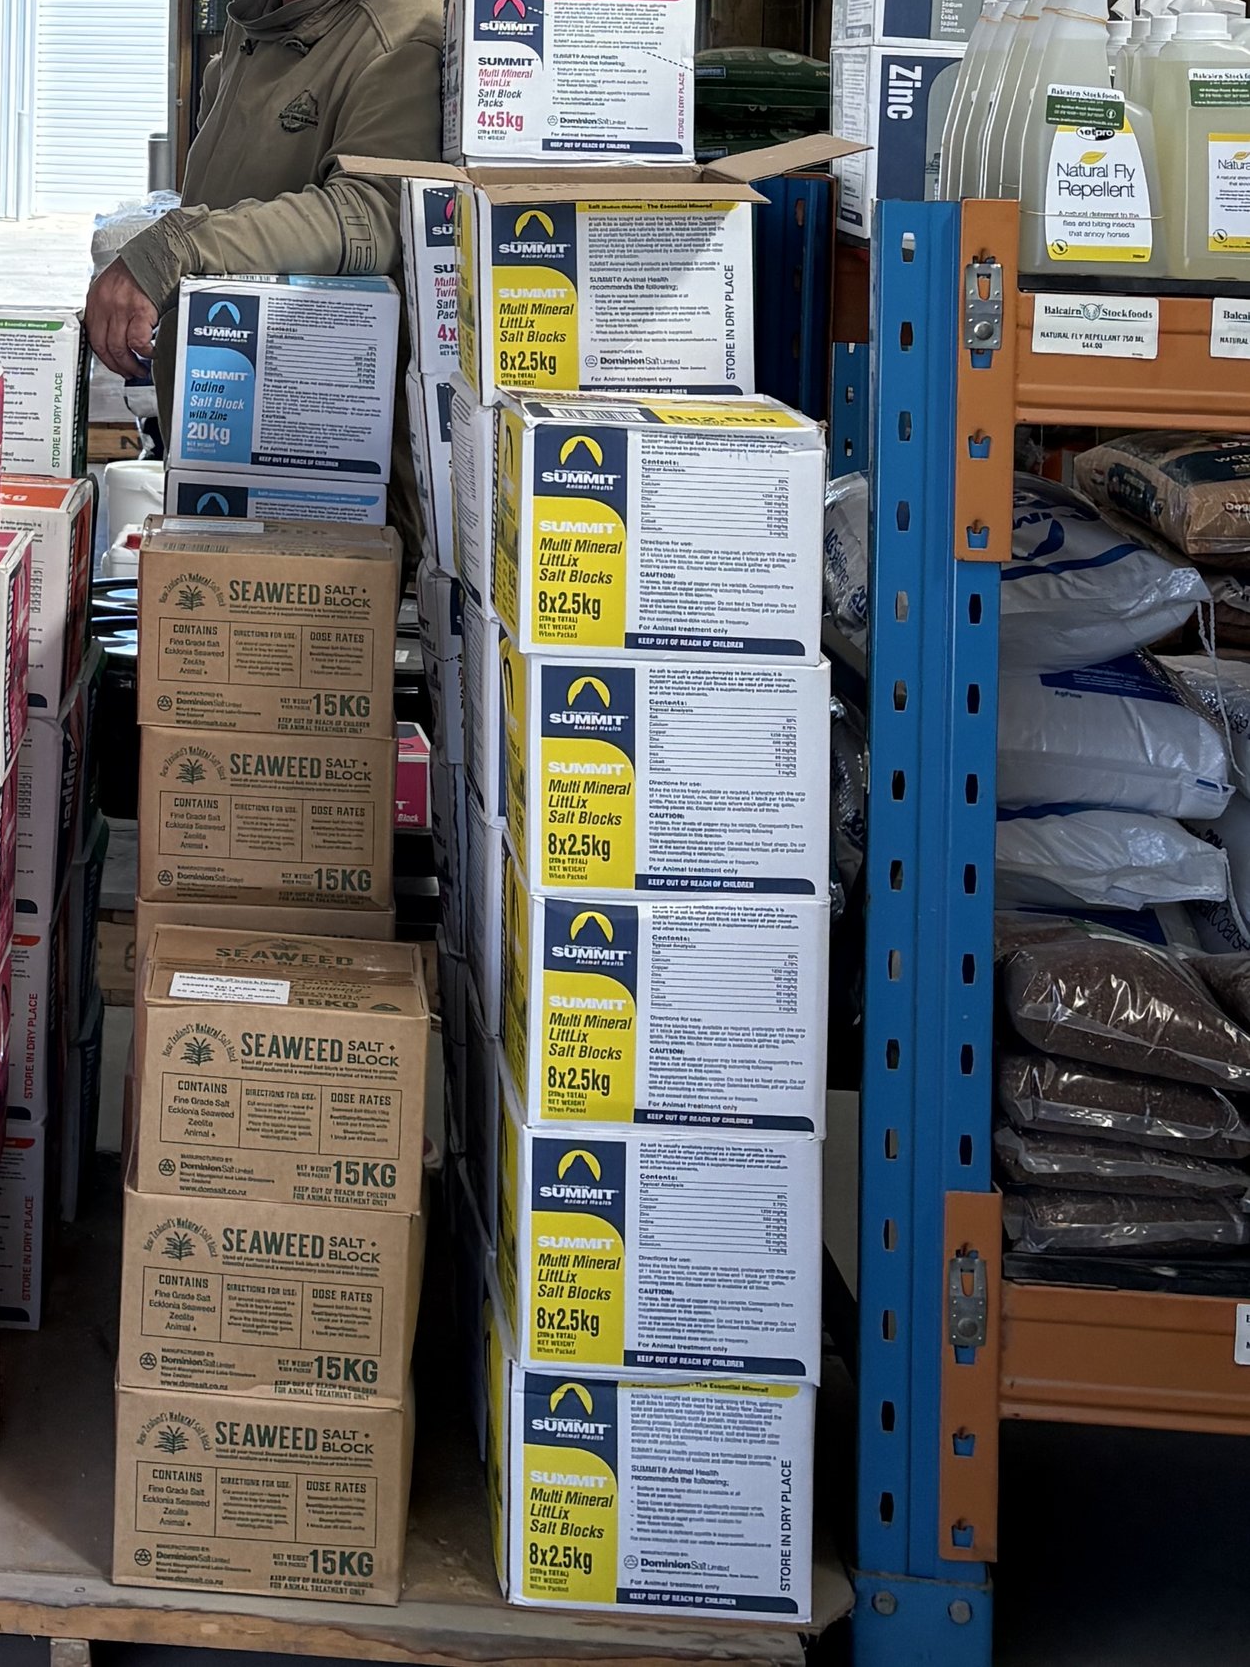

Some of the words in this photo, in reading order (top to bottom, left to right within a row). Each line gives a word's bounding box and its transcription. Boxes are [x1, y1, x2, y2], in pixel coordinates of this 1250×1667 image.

[479, 22, 535, 32] SUMMIT
[478, 57, 535, 66] SUMMIT
[478, 69, 499, 78] Multi
[501, 70, 533, 78] Mineral
[478, 78, 511, 87] TwinLix
[478, 89, 496, 99] Salt
[498, 89, 522, 99] Block
[887, 64, 922, 119] Zinc
[1051, 88, 1081, 97] Balcairn
[1083, 90, 1120, 100] Stockfoods
[478, 99, 503, 108] Packs
[477, 111, 524, 131] 4x5kg
[1057, 163, 1108, 178] Natural
[1115, 164, 1135, 181] Fly
[1058, 180, 1135, 200] Repellent
[1092, 221, 1110, 229] biting
[499, 243, 567, 254] SUMMIT
[724, 264, 734, 301] PLACE
[499, 288, 567, 299] SUMMIT
[499, 303, 528, 315] Multi
[530, 304, 574, 315] Mineral
[725, 304, 734, 325] DRY
[1044, 306, 1081, 316] Balcairn
[1102, 308, 1153, 319] Stockfoods
[499, 317, 535, 329] LittLix
[193, 328, 251, 338] SUMMIT
[500, 331, 524, 343] Salt
[527, 331, 567, 343] Blocks
[725, 328, 735, 339] IN
[1040, 332, 1069, 340] NATURAL
[1085, 334, 1120, 342] REPELLANT
[500, 350, 556, 374] 8x2.5kg
[725, 342, 735, 380] STORE
[190, 369, 248, 381] SUMMIT
[55, 373, 63, 401] PLACE
[191, 381, 225, 394] Iodine
[190, 395, 212, 407] Salt
[215, 398, 245, 410] Block
[54, 403, 62, 423] DRY
[189, 411, 207, 420] with
[209, 411, 227, 421] Zinc
[53, 425, 61, 435] IN
[187, 422, 230, 445] 20kg
[52, 437, 60, 468] STORE
[229, 580, 320, 606] SEAWEED
[548, 833, 610, 861] 8x2.5kg
[215, 947, 354, 966] SEAWEED
[27, 993, 38, 1031] PLACE
[26, 1033, 36, 1050] DRY
[241, 1032, 342, 1062] SEAWEED
[348, 1041, 384, 1052] SALT
[25, 1050, 34, 1067] IN
[347, 1054, 399, 1067] BLOCK
[24, 1070, 33, 1099] STORE
[177, 1081, 228, 1094] CONTAINS
[548, 1066, 610, 1095] 8x2.5kg
[174, 1096, 189, 1104] Fine
[191, 1097, 213, 1106] Grade
[215, 1098, 230, 1107] Salt
[331, 1092, 355, 1104] DOSE
[359, 1095, 391, 1106] RATES
[201, 1109, 234, 1119] Seaweed
[184, 1128, 210, 1137] Animal
[333, 1160, 396, 1187] 15KG
[222, 1228, 324, 1259] SEAWEED
[537, 1307, 600, 1337] 8x2.5kg
[531, 1419, 606, 1434] SUMMIT
[215, 1421, 318, 1451] SEAWEED
[530, 1470, 606, 1487] SUMMIT
[530, 1488, 562, 1504] Multi
[565, 1491, 613, 1507] Mineral
[530, 1504, 569, 1520] LittLix
[530, 1519, 557, 1535] Salt
[560, 1521, 605, 1538] Blocks
[529, 1542, 592, 1574] 8x2.5kg
